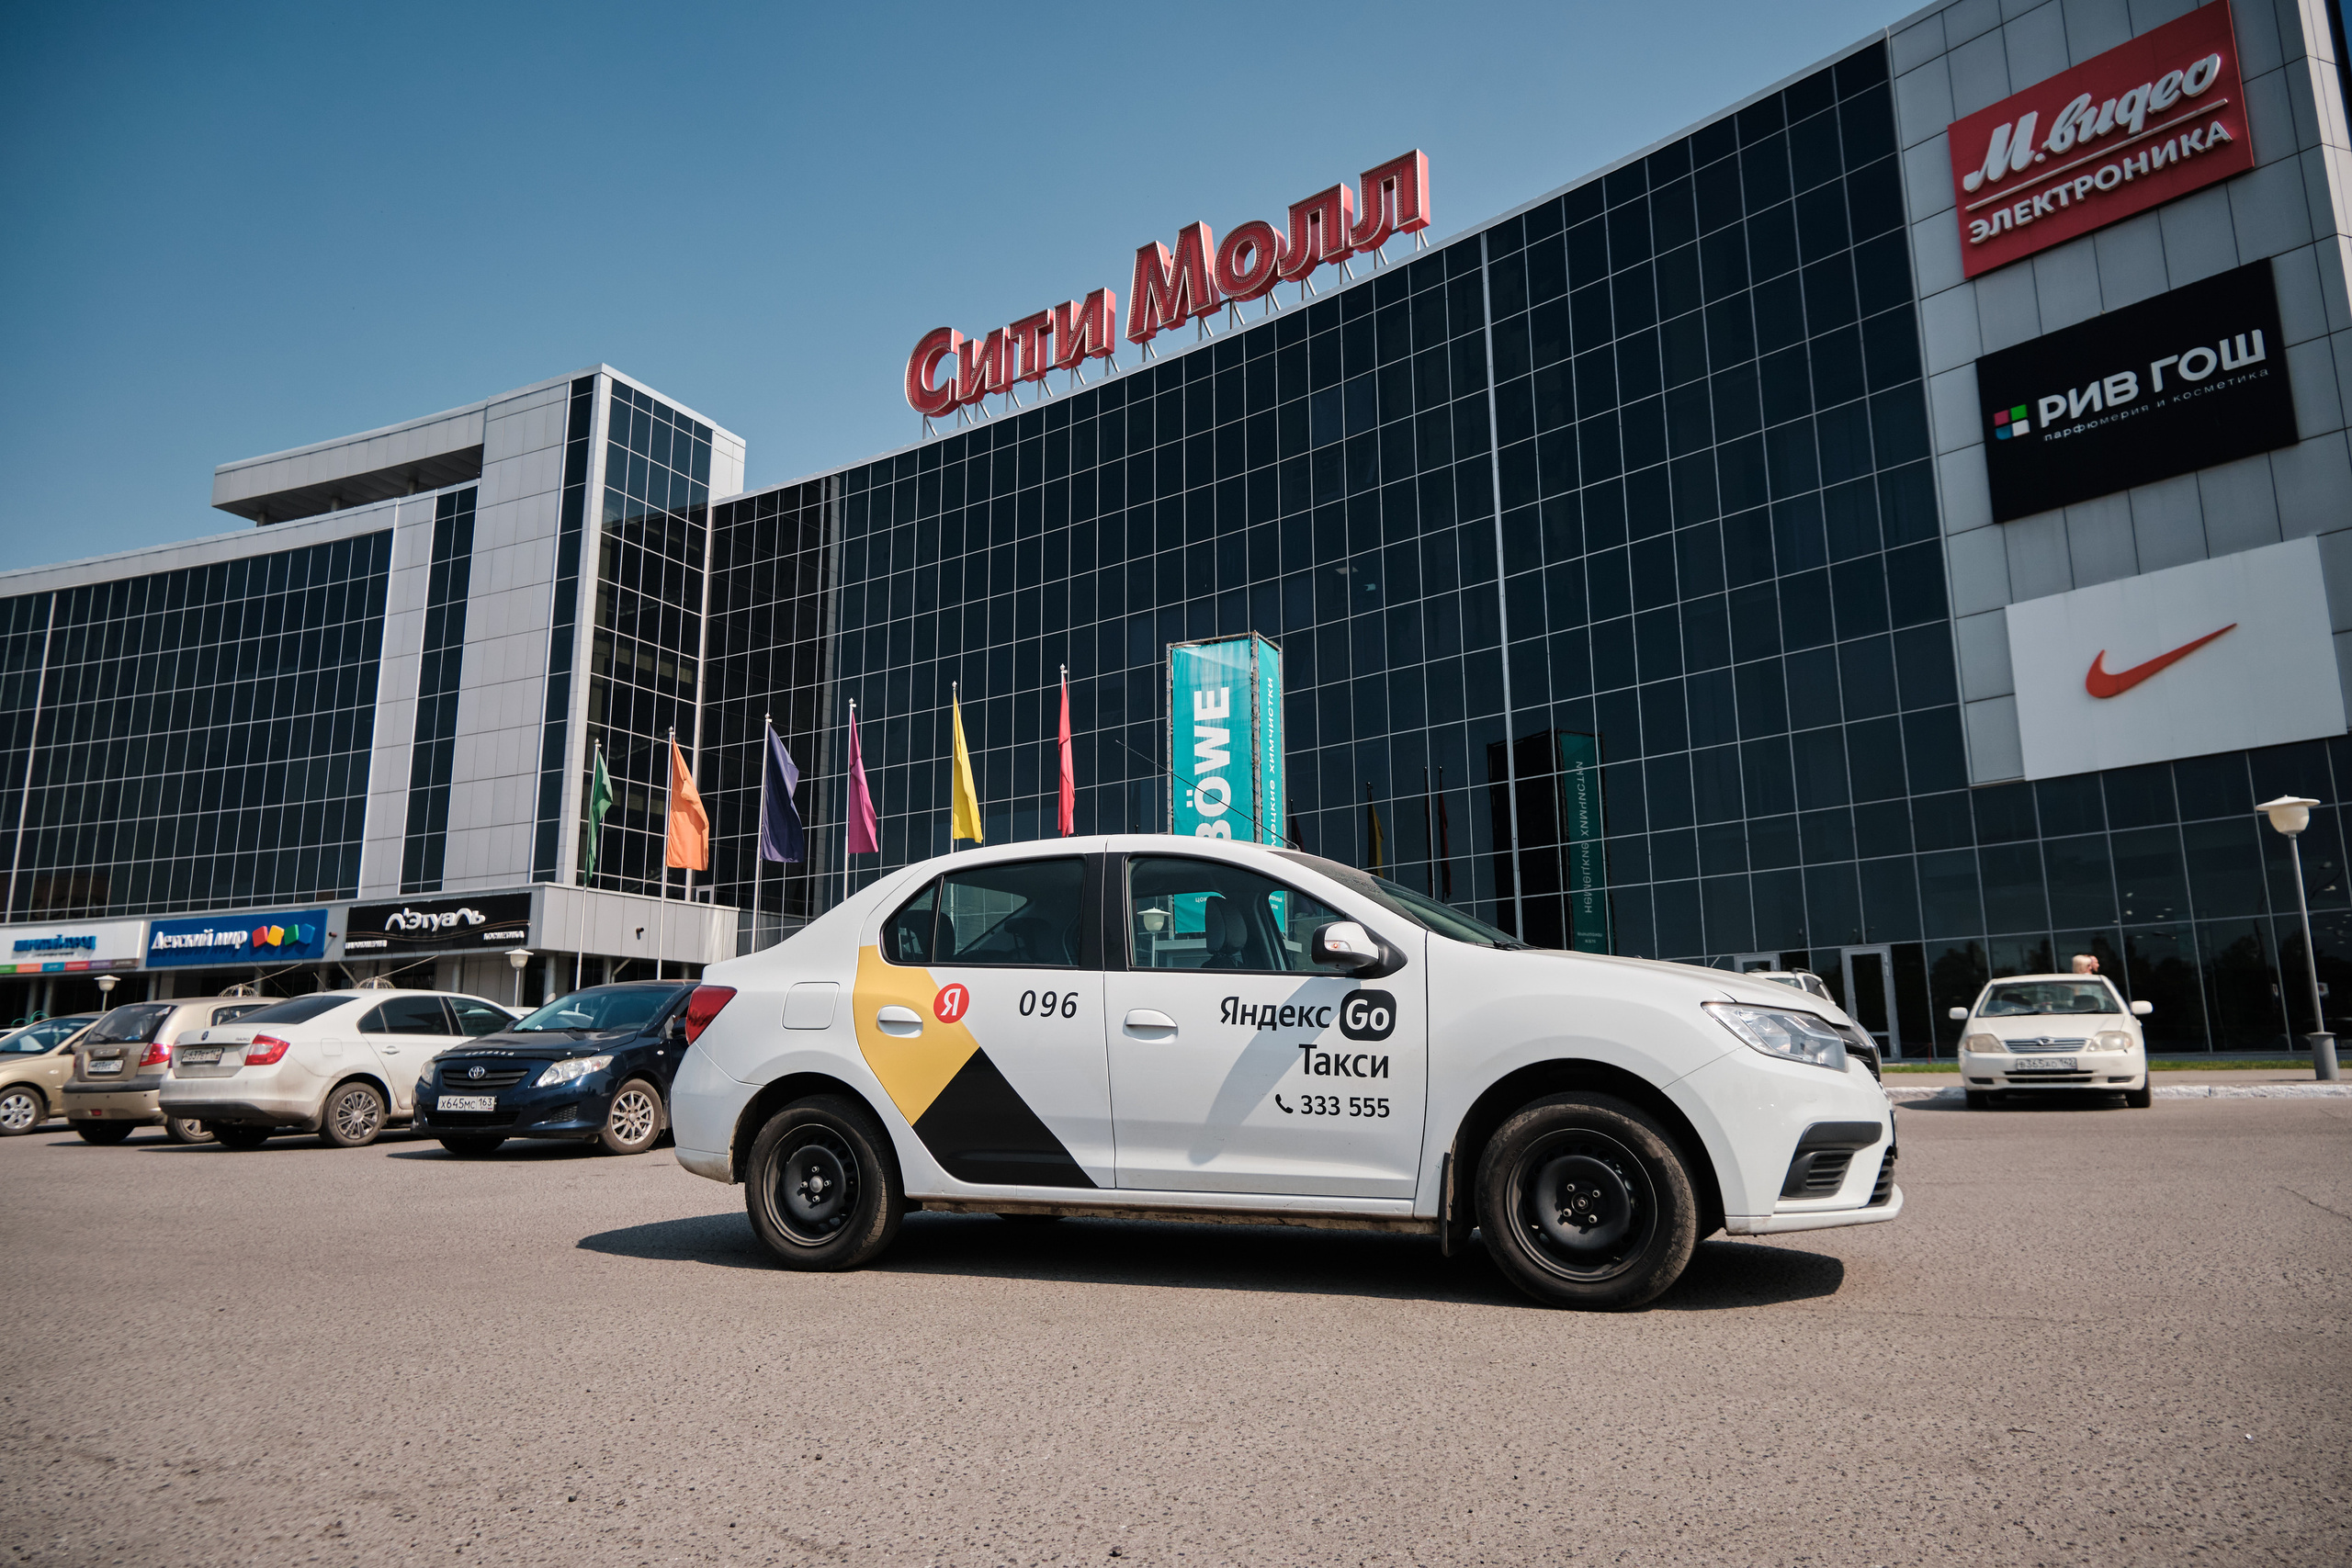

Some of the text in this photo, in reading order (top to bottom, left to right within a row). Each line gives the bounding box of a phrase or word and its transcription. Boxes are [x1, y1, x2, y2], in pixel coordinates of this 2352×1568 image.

[1969, 120, 2233, 244] ЭЛЕКТРОНИКА
[2038, 329, 2267, 428] РИВ ГОШ
[2044, 368, 2269, 442] парфюмерия и косметика
[1267, 677, 1279, 847] мецкие химчистки
[151, 929, 248, 950] Детский мир
[1019, 989, 1079, 1019] 096
[1220, 996, 1331, 1031] Яндекс
[1345, 998, 1390, 1032] Go
[1298, 1043, 1389, 1078] Такси
[479, 1098, 492, 1107] 163
[1300, 1094, 1390, 1119] 333 555
